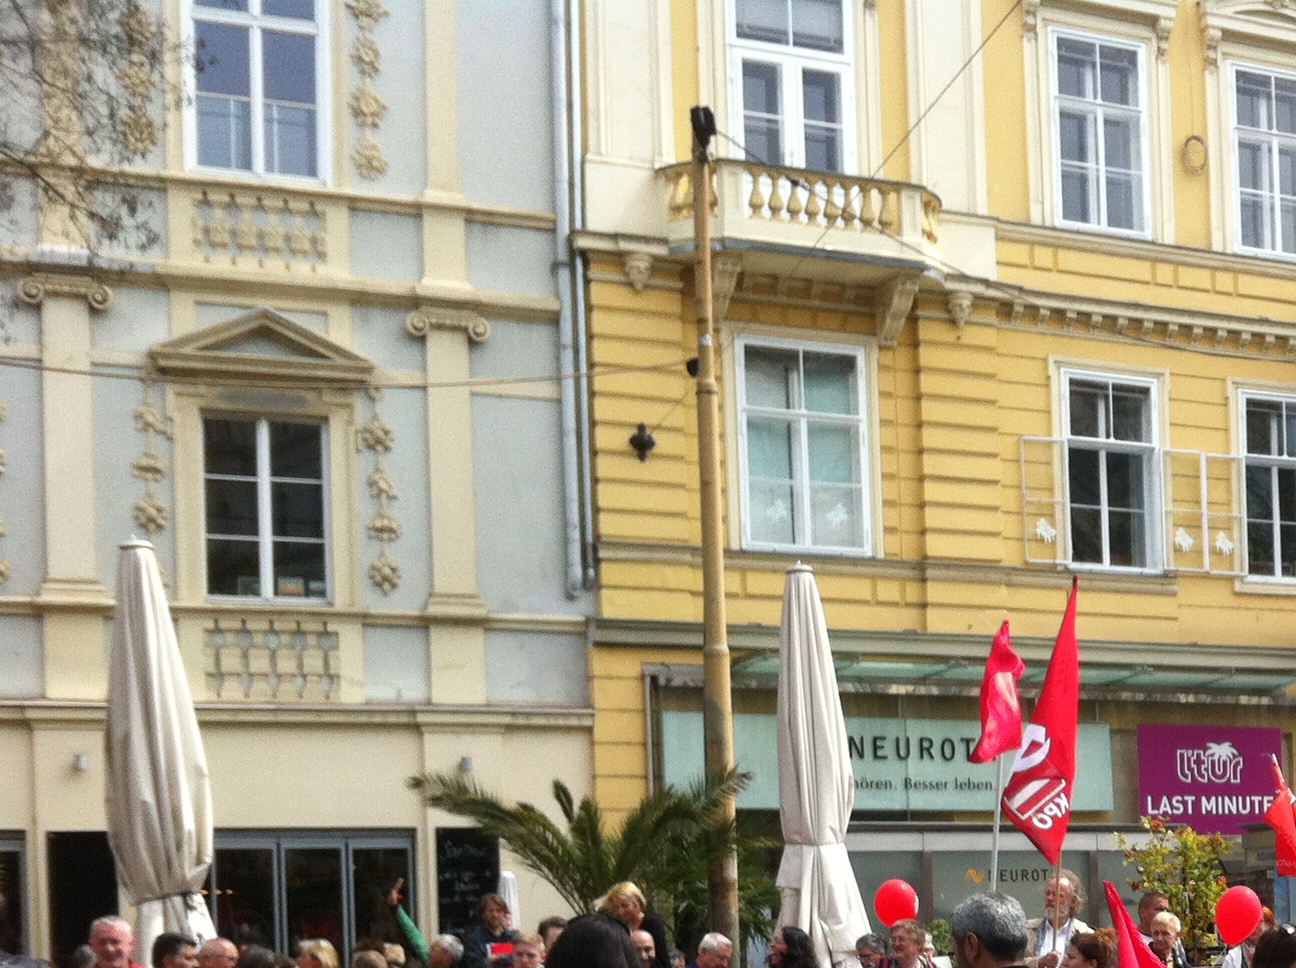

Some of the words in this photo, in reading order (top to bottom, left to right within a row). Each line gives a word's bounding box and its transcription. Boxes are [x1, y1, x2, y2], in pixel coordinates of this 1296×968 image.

[849, 735, 977, 762] NEUROT
[904, 775, 948, 791] Besser
[1147, 795, 1196, 815] LAST
